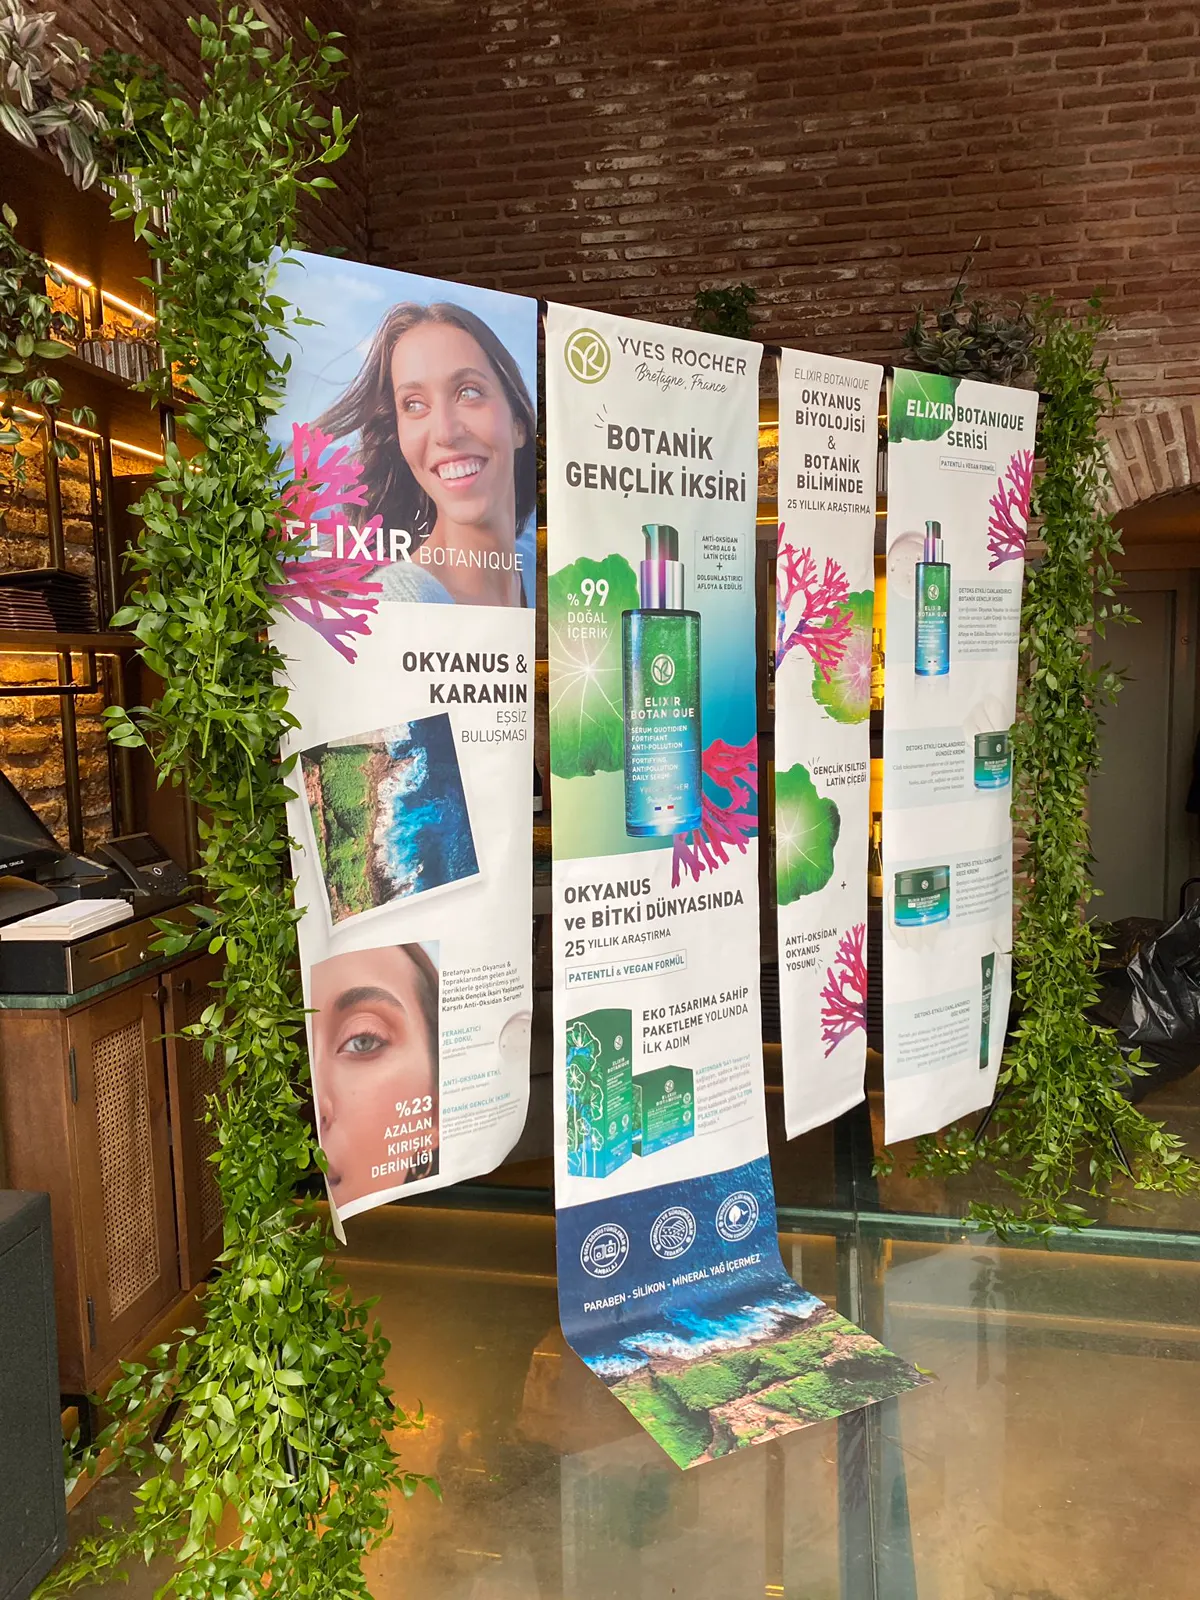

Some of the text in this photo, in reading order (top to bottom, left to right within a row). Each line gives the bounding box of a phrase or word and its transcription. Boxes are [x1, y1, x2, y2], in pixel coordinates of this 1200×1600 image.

[617, 336, 747, 376] YVES ROCHER
[691, 373, 728, 393] France
[794, 368, 869, 390] ELIXIR BOTANIQUE
[802, 389, 861, 412] OKYANUS
[795, 410, 865, 433] BİYOLOJİSİ
[906, 399, 1024, 431] ELIXIR BOTANIQUE
[607, 423, 713, 461] BOTANİK
[828, 435, 836, 450] &
[947, 429, 988, 450] SERİSİ
[804, 453, 860, 474] BOTANİK
[565, 461, 747, 502] GENÇLİK İKSİRİ
[797, 471, 863, 494] BİLİMİNDE
[787, 499, 871, 514] 25 YILLIK ARAŞTIRMA
[419, 546, 524, 572] BOTANIQUE
[568, 609, 608, 624] DOĞAL
[568, 625, 608, 641] İÇERİK
[402, 651, 528, 673] OKYANUS &
[429, 684, 528, 704] KARANIN
[496, 710, 527, 726] EŞSİZ
[630, 708, 695, 720] BOTANQUE
[461, 730, 527, 745] BULUŞMASI
[653, 725, 688, 733] QUOTIDIEN
[813, 762, 844, 776] GENÇLİK
[826, 775, 845, 787] LATİN
[564, 878, 651, 904] OKYANUS
[564, 889, 744, 931] ve BİTKİ DÜNYASINDA
[565, 928, 672, 958] 25 YILLIK ARAŞTIRMA
[785, 928, 837, 946] ANTİ-OKSİDAN
[786, 945, 821, 959] OKYANUS
[568, 966, 615, 983] PATENTLİ
[623, 963, 653, 976] VEGAN
[655, 955, 685, 971] FORMÜL
[786, 957, 816, 972] YOSUNU
[642, 986, 749, 1022] EKO TASARIMA SAHİP
[642, 1003, 749, 1038] PAKETLEME YOLUNDA
[642, 1034, 691, 1056] İLK ADIM
[395, 1095, 433, 1118] %23
[384, 1117, 432, 1139] AZALAN
[388, 1134, 433, 1156] KIRIŞIK
[371, 1149, 433, 1178] DERİNLİĞİ
[584, 1292, 626, 1312] PARABEN
[632, 1280, 666, 1299] SİLİKON
[672, 1270, 709, 1287] MİNERAL
[710, 1262, 725, 1276] YAĞ
[726, 1253, 761, 1272] İÇERMEZ
